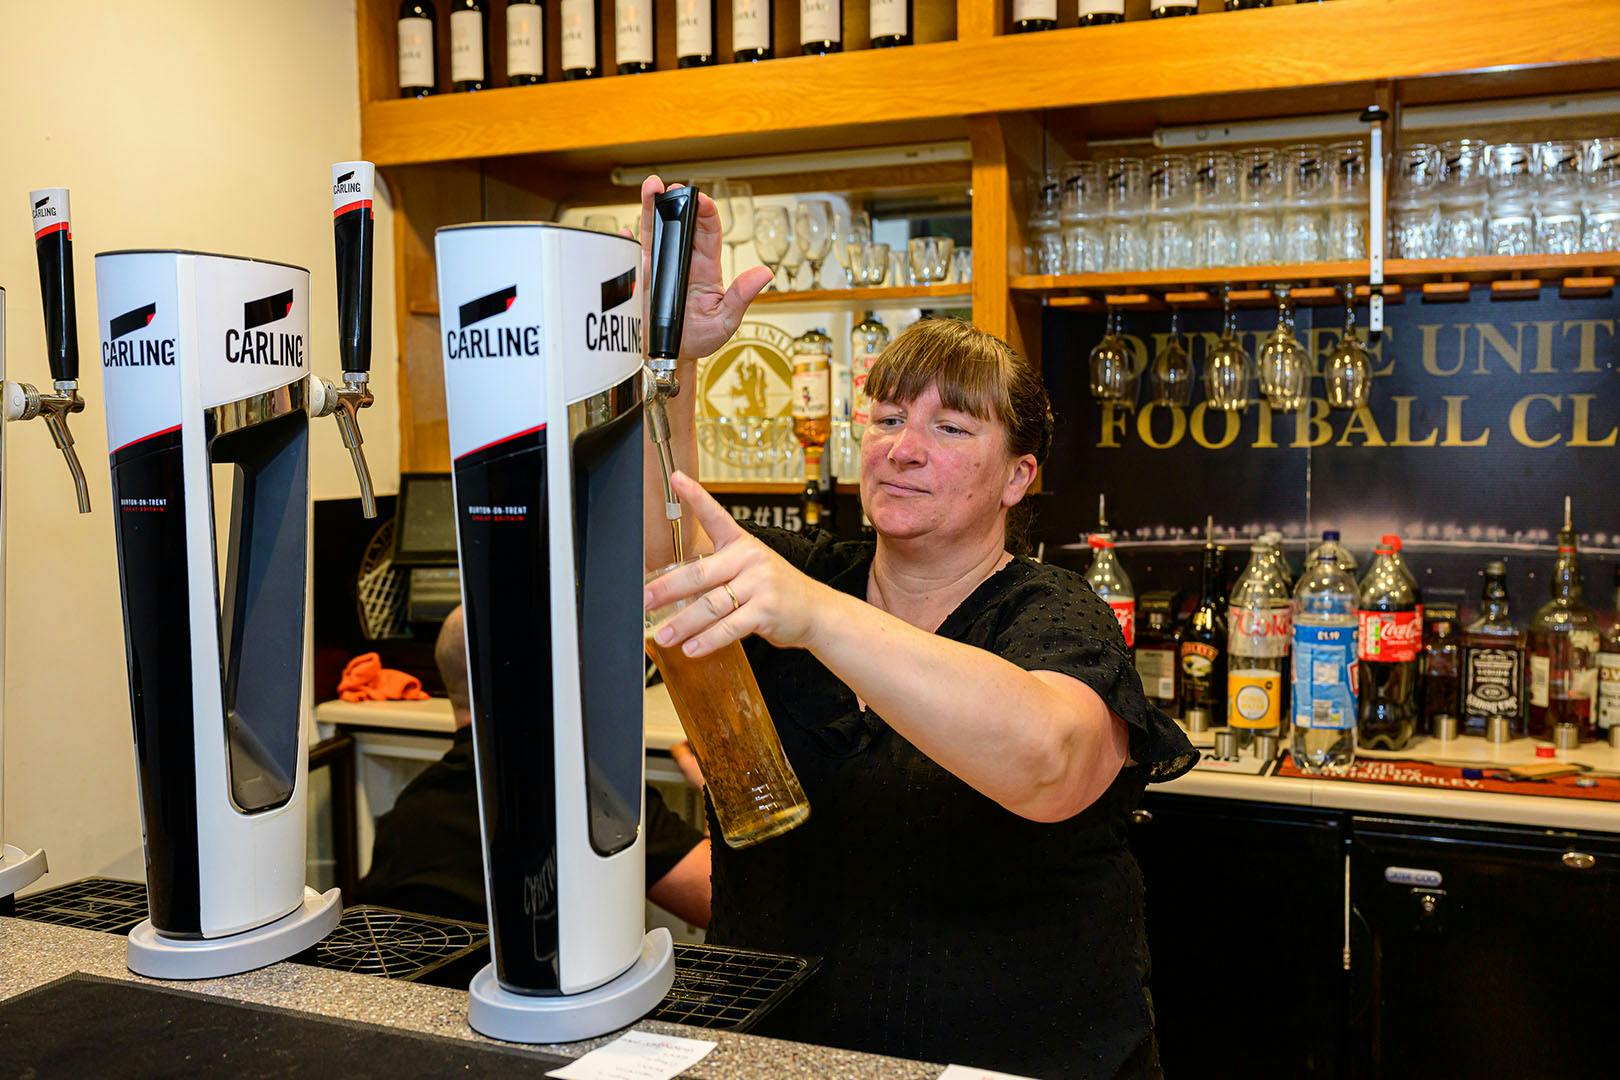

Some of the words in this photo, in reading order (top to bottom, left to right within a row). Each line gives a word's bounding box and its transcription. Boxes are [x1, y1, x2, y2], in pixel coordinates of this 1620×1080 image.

[333, 183, 361, 194] CARLING
[102, 338, 175, 368] CARLING
[225, 328, 304, 368] CARLING
[448, 326, 540, 360] CARLING
[1418, 319, 1620, 377] UNIT
[1095, 394, 1491, 450] FOOTBALL
